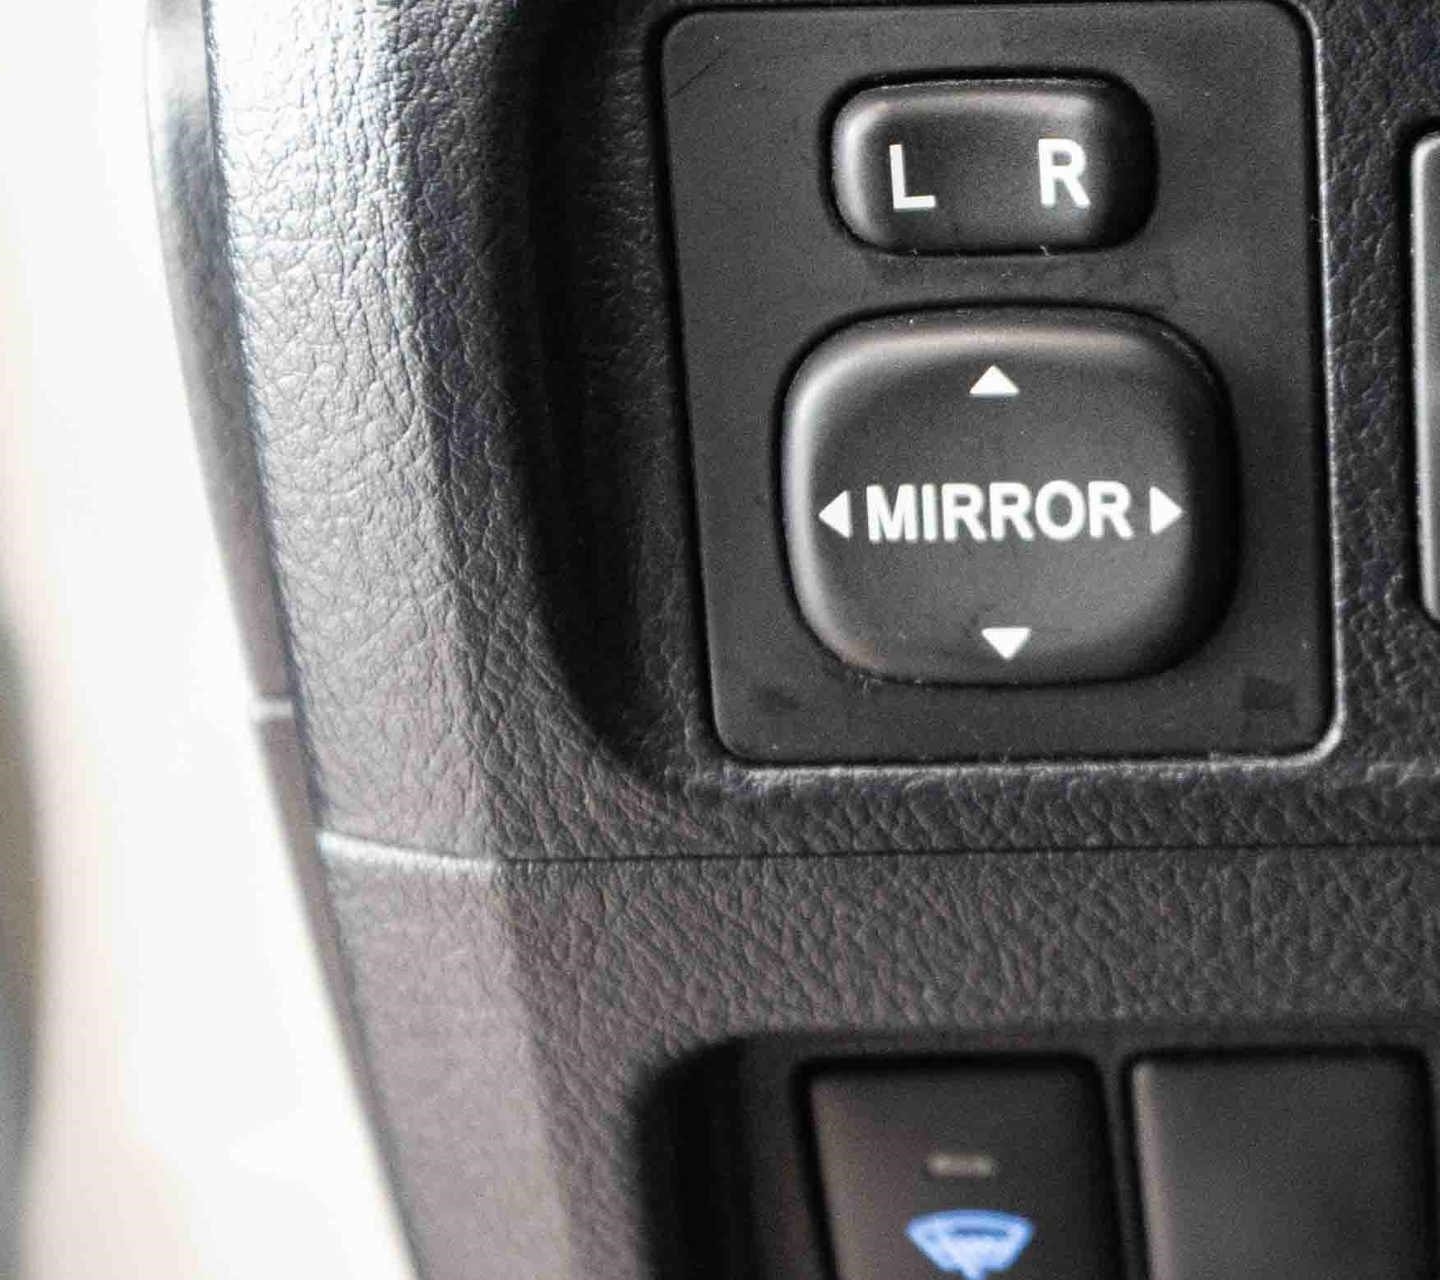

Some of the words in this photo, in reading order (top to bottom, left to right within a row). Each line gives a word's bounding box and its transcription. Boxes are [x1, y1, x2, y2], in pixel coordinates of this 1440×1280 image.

[889, 143, 936, 210] L
[1037, 137, 1091, 209] R
[865, 479, 1136, 544] MIRROR
